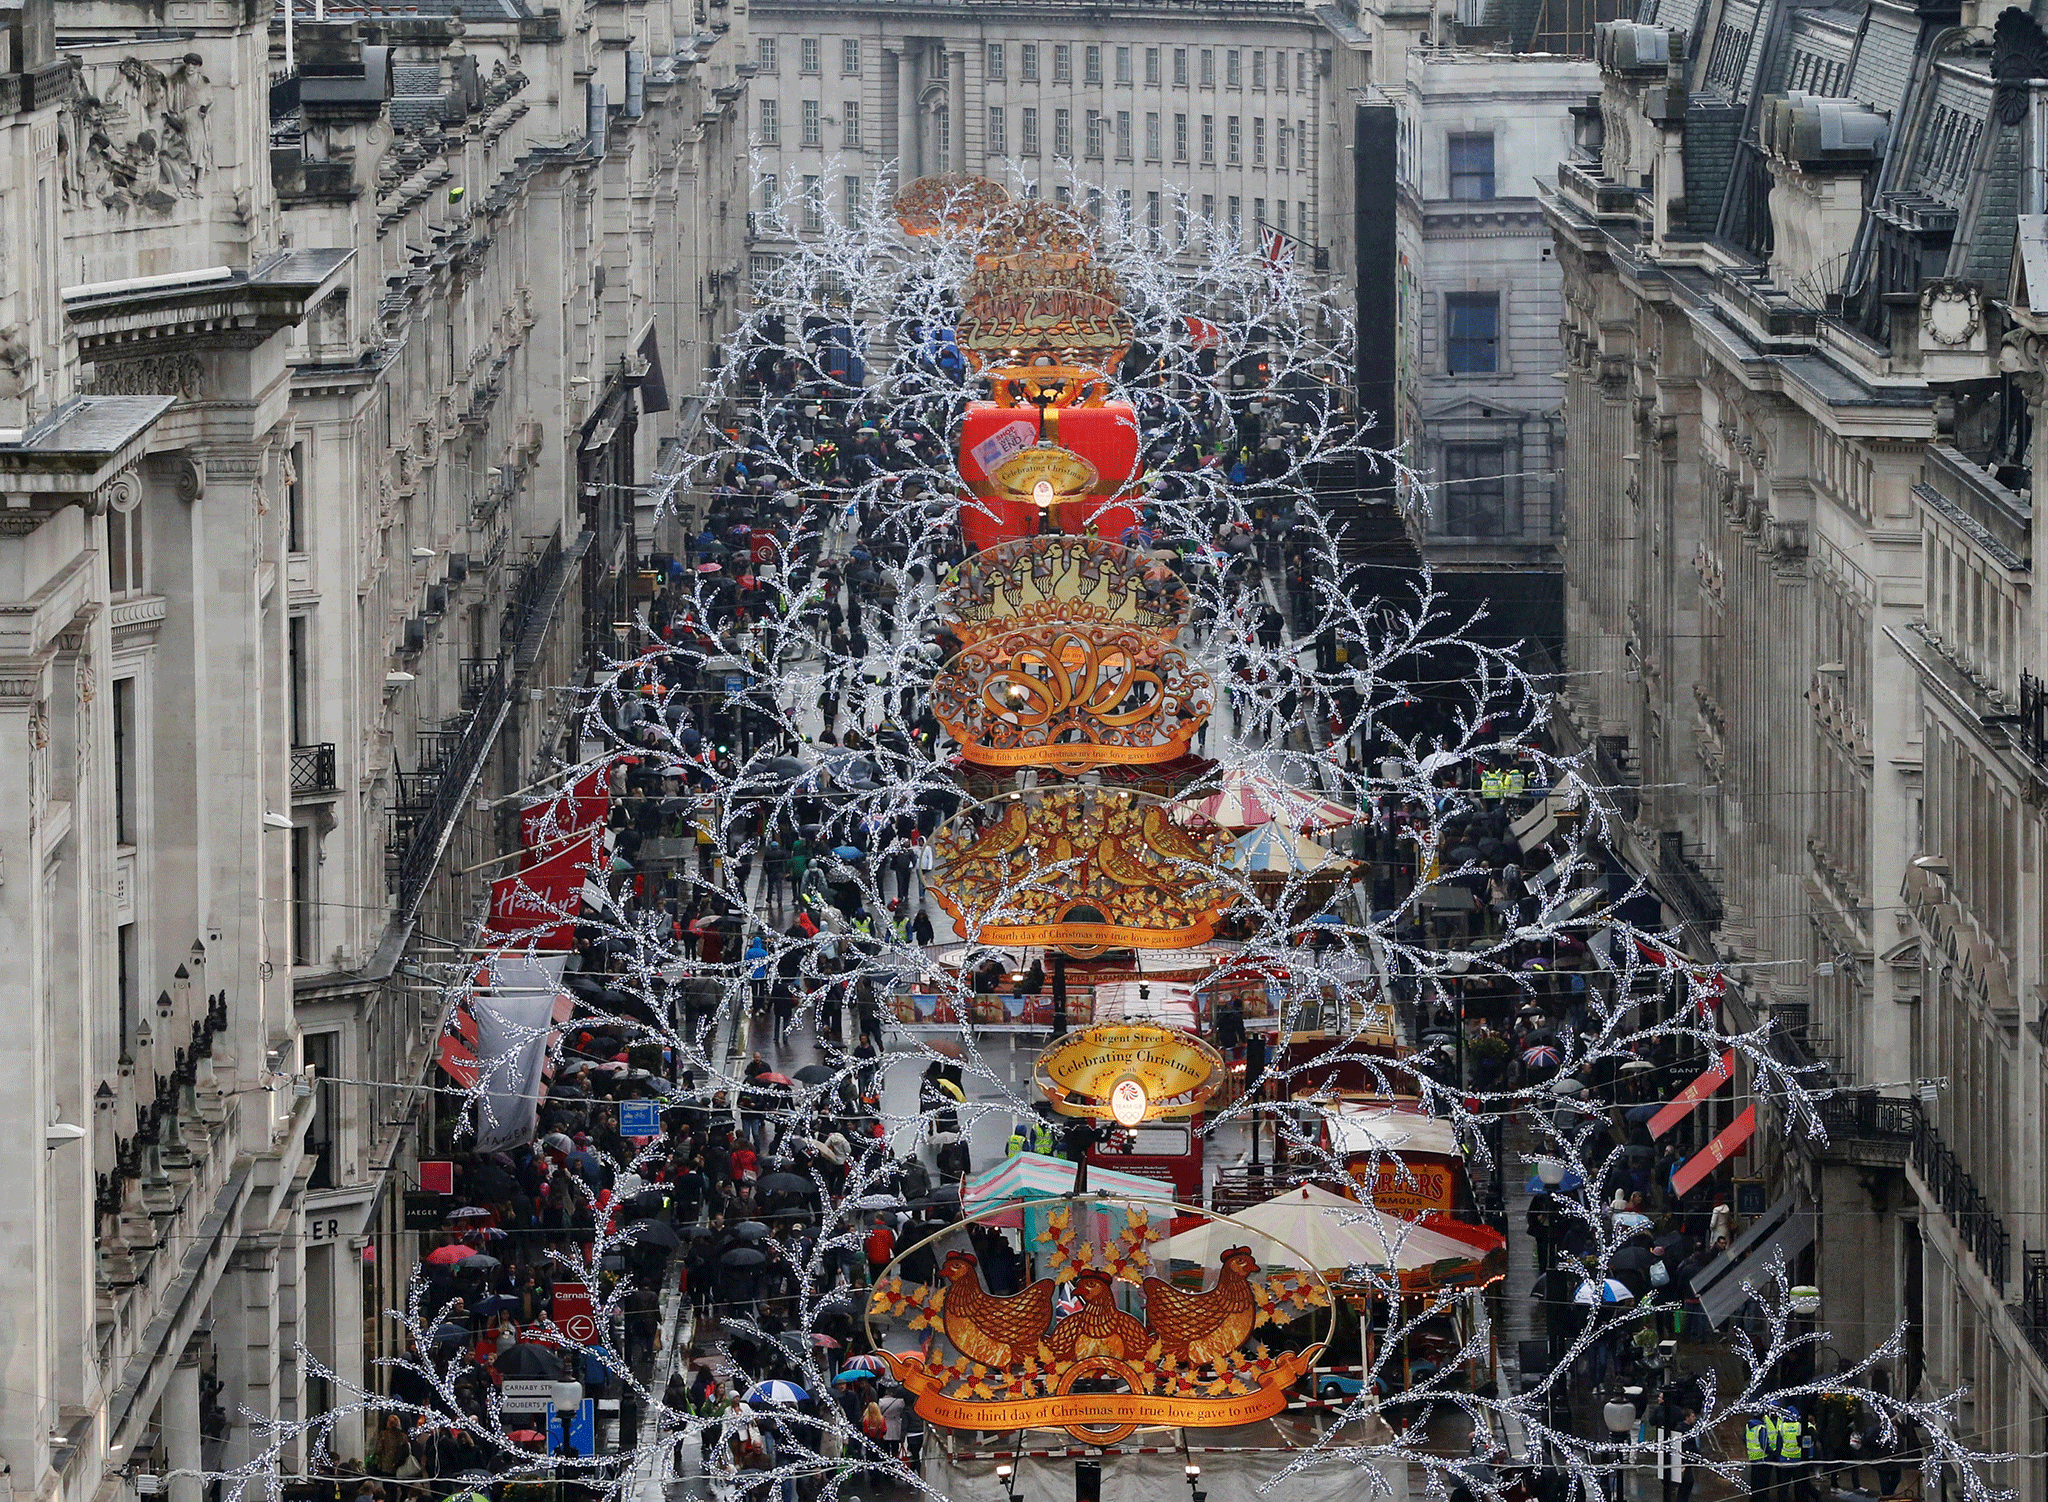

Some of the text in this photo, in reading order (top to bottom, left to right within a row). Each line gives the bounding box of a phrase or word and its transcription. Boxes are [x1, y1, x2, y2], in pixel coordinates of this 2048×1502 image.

[995, 425, 1015, 442] SHOP
[1001, 436, 1022, 452] END
[1001, 465, 1046, 481] Celebrating
[1039, 748, 1076, 758] Christmas
[494, 885, 579, 917] Hamleys
[992, 931, 1018, 941] fourth
[1020, 931, 1036, 942] day
[1038, 929, 1048, 939] of
[1049, 929, 1093, 939] Christmas
[1095, 932, 1110, 941] my
[1111, 932, 1129, 941] true
[1131, 932, 1149, 942] love
[1151, 935, 1171, 945] gave
[1173, 934, 1182, 943] to
[1094, 1032, 1165, 1045] Regent Street
[1058, 1050, 1201, 1080] Celebrating Christmas
[1350, 1172, 1444, 1202] CRTERS
[1374, 1197, 1423, 1205] FAMOUS
[304, 1219, 339, 1241] ER
[555, 1291, 591, 1299] Carnab
[506, 1401, 540, 1409] FOUBERTS
[934, 1406, 951, 1417] on
[952, 1407, 974, 1421] the
[976, 1408, 1007, 1422] third
[1010, 1408, 1031, 1424] day
[1035, 1405, 1049, 1419] of
[1051, 1404, 1114, 1418] Christmas
[1117, 1406, 1136, 1420] my
[1139, 1405, 1165, 1417] true
[1168, 1403, 1194, 1419] love
[1197, 1408, 1226, 1421] gave
[1228, 1405, 1241, 1418] to
